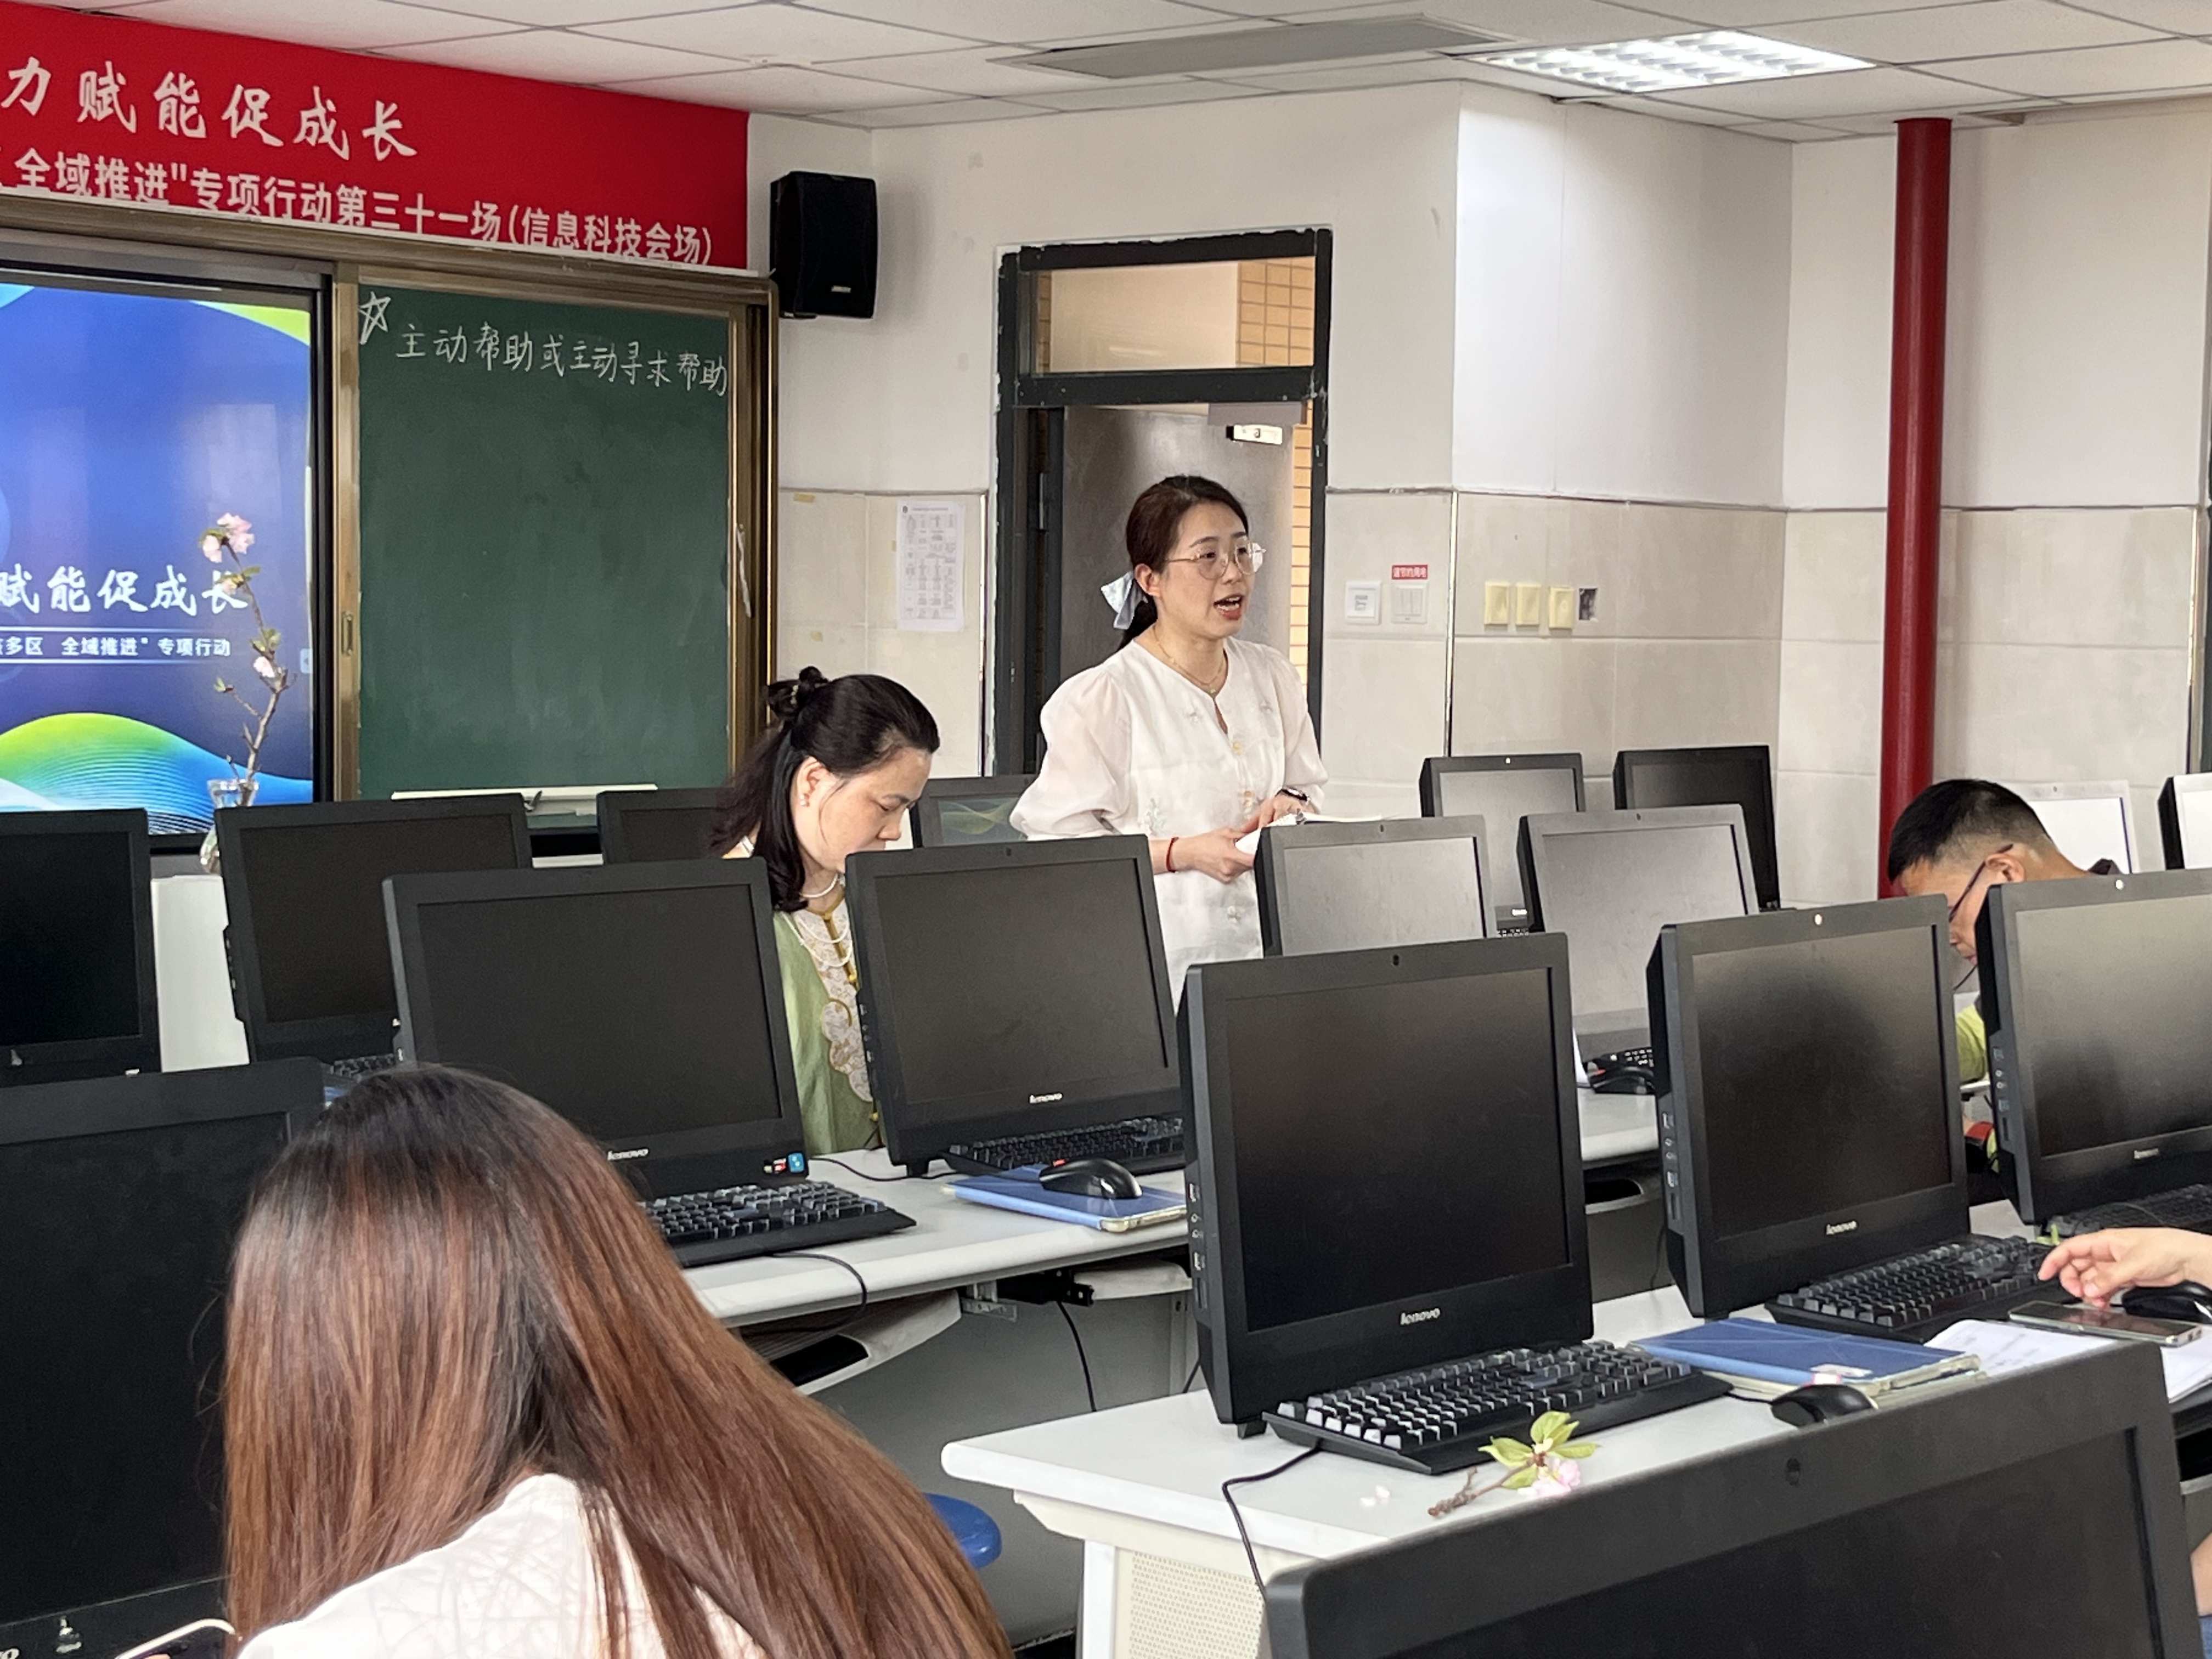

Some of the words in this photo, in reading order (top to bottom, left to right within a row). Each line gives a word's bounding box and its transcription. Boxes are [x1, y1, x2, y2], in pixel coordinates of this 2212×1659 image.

[1, 56, 417, 161] 力赋能促成长
[396, 320, 728, 396] 主动帮助或主动寻求帮助
[0, 637, 43, 656] 多区
[1028, 1092, 1063, 1104] lenovo
[607, 1148, 649, 1161] lenovo
[1401, 1308, 1440, 1325] lenovo
